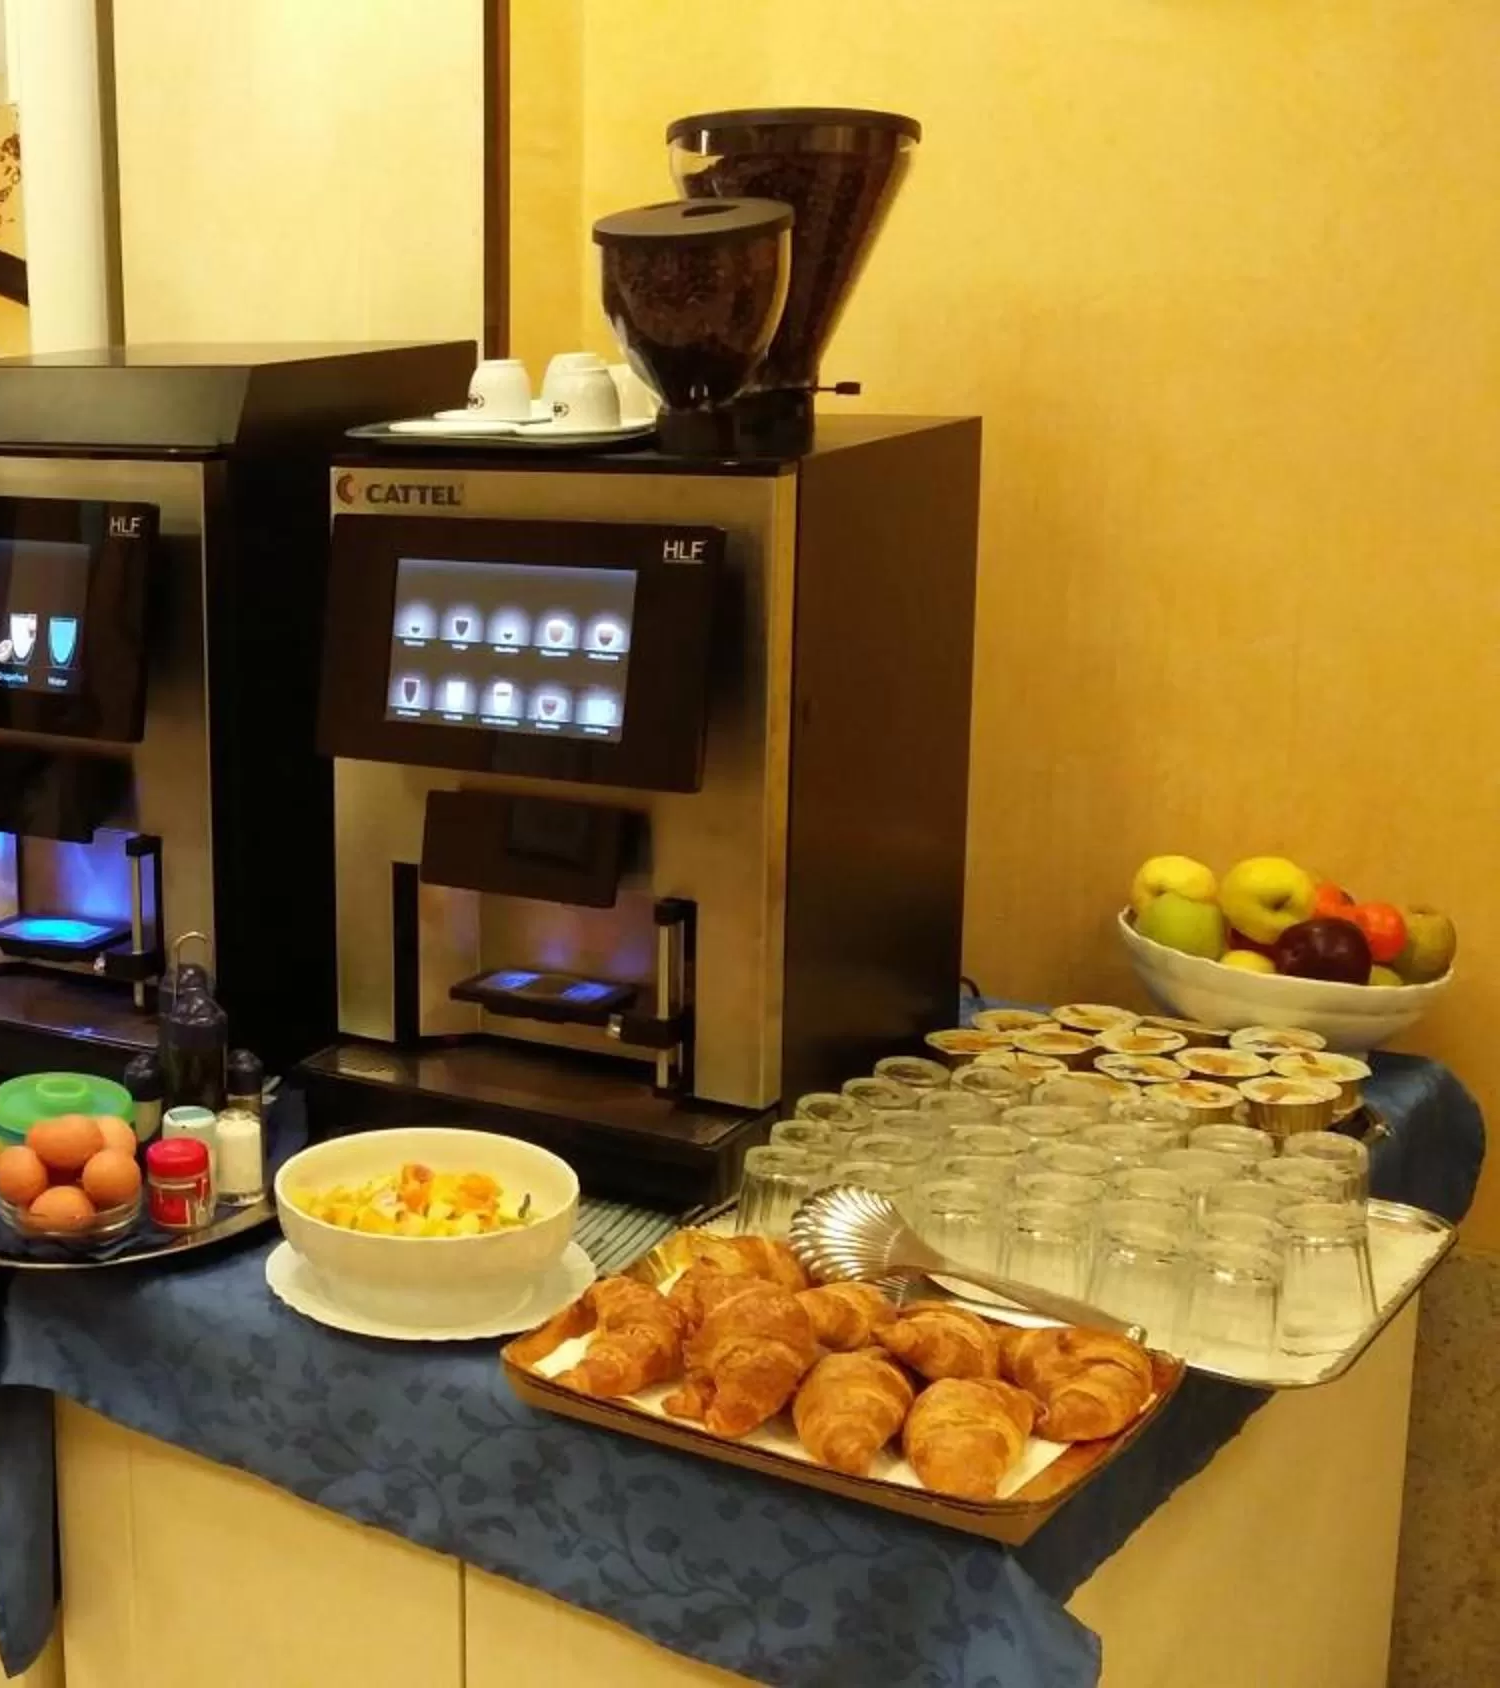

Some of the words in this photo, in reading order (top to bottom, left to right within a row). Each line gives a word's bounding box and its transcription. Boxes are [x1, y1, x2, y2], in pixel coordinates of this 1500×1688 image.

[366, 482, 462, 506] CATTEL
[110, 516, 143, 534] HLF
[663, 540, 708, 560] HLF
